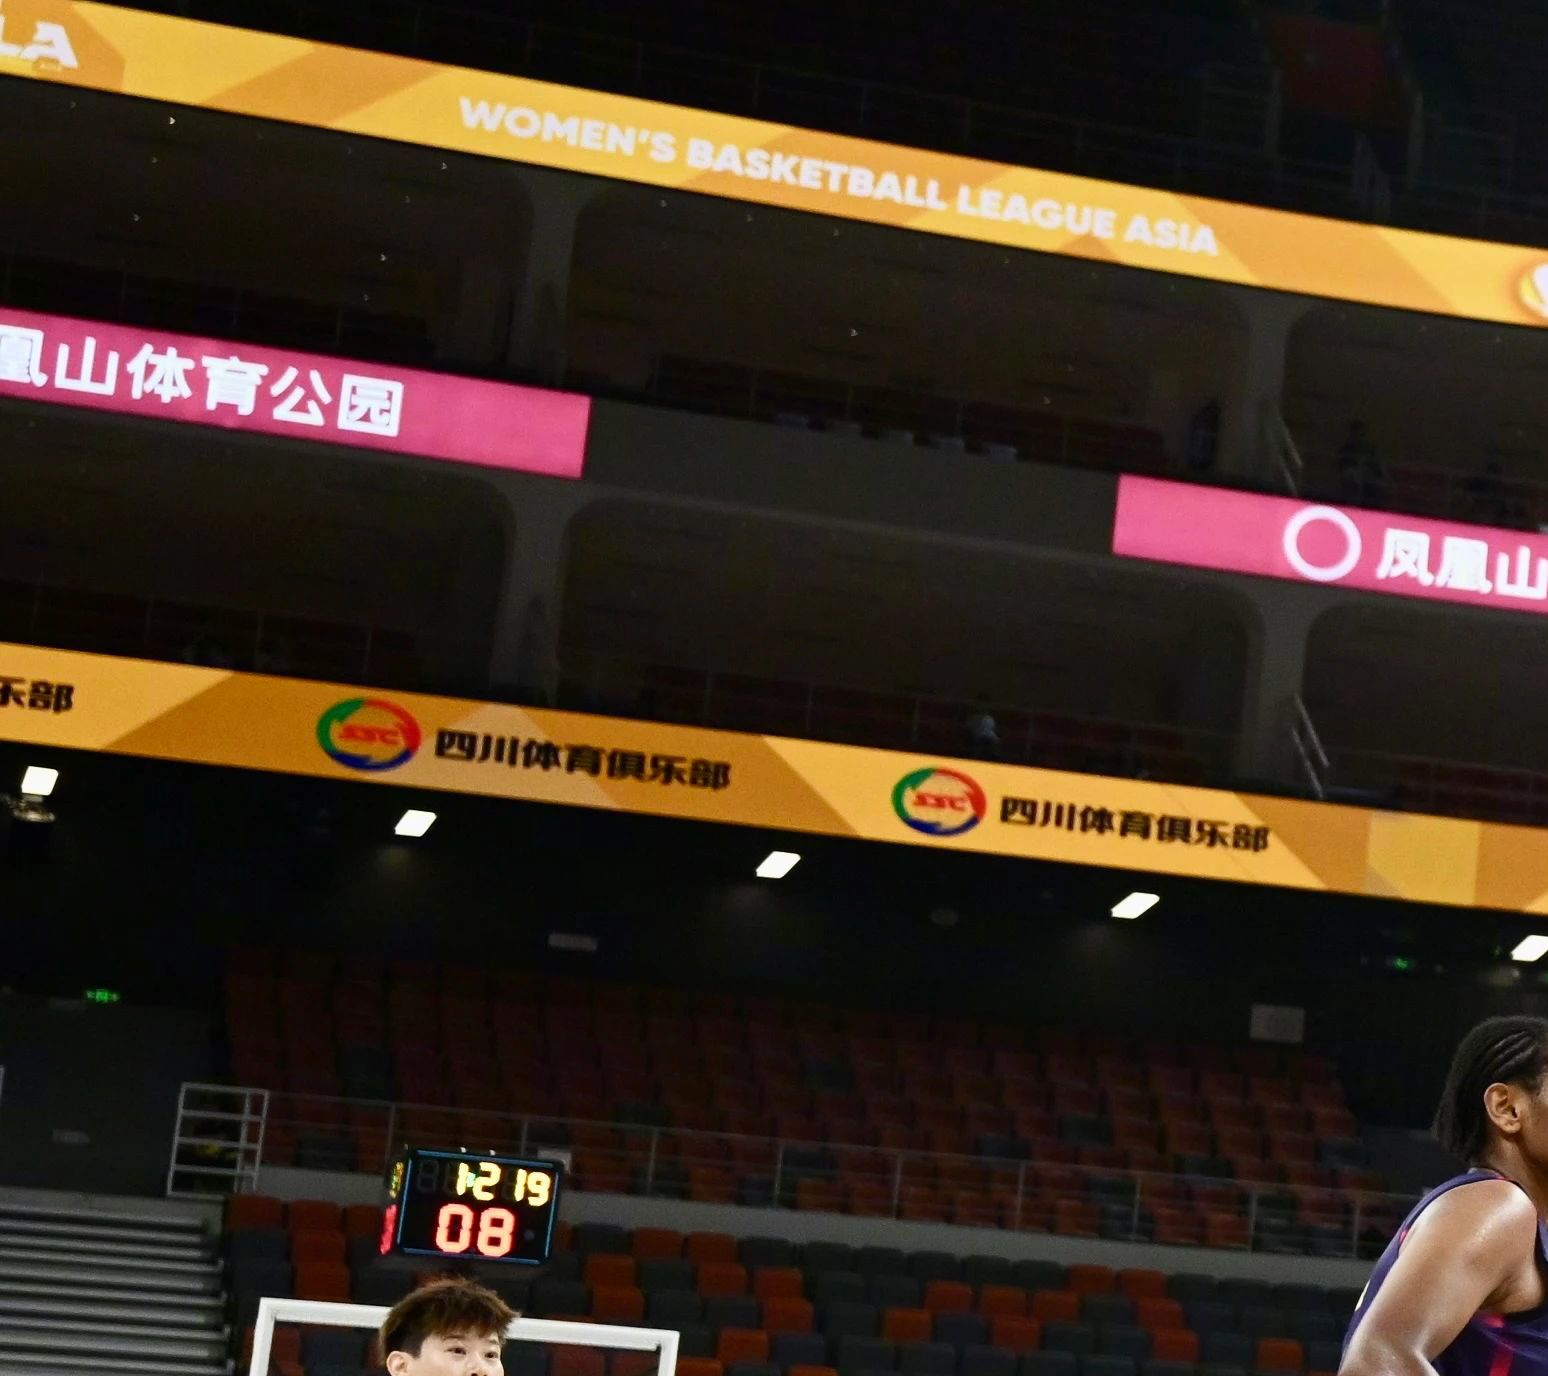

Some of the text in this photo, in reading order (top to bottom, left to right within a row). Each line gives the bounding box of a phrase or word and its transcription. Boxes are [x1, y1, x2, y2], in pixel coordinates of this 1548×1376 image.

[459, 96, 1219, 258] WOMEN'S BASKETBALL LEAGUE ASIA
[434, 728, 732, 793] 四川体育俱乐部
[1000, 795, 1270, 854] 四川体育俱乐部
[435, 1204, 515, 1256] 08
